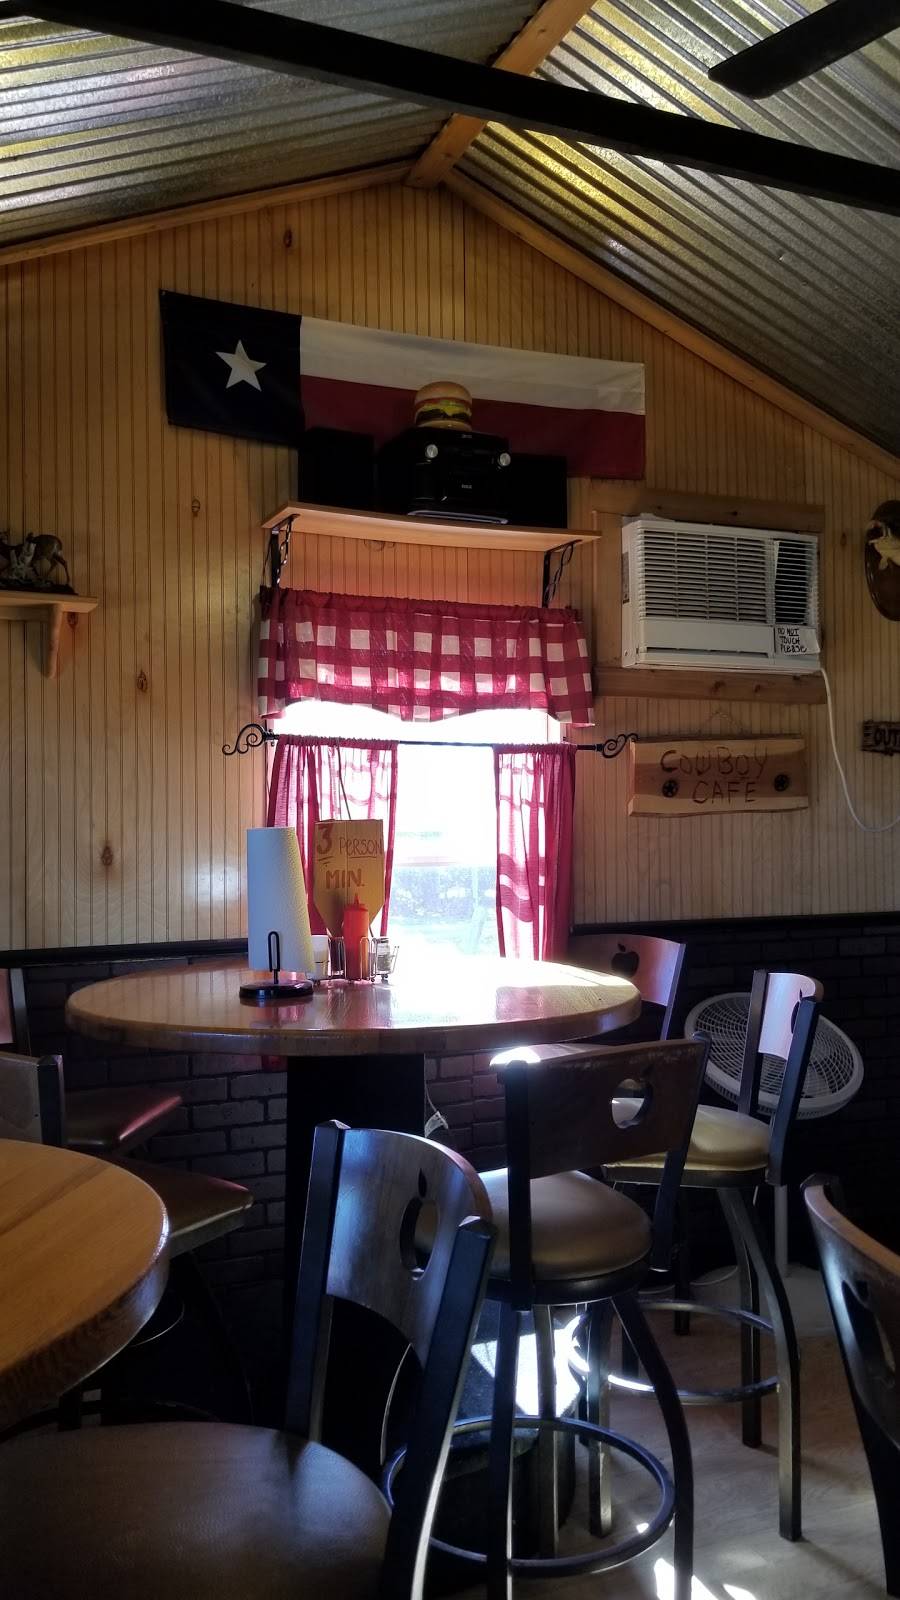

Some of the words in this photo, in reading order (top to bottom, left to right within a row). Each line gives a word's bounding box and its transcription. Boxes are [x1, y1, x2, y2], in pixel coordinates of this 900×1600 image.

[779, 635, 800, 645] TOUCH
[787, 627, 799, 635] NOT
[692, 780, 757, 805] CAFE
[316, 822, 335, 855] 3
[325, 867, 366, 889] MIN.
